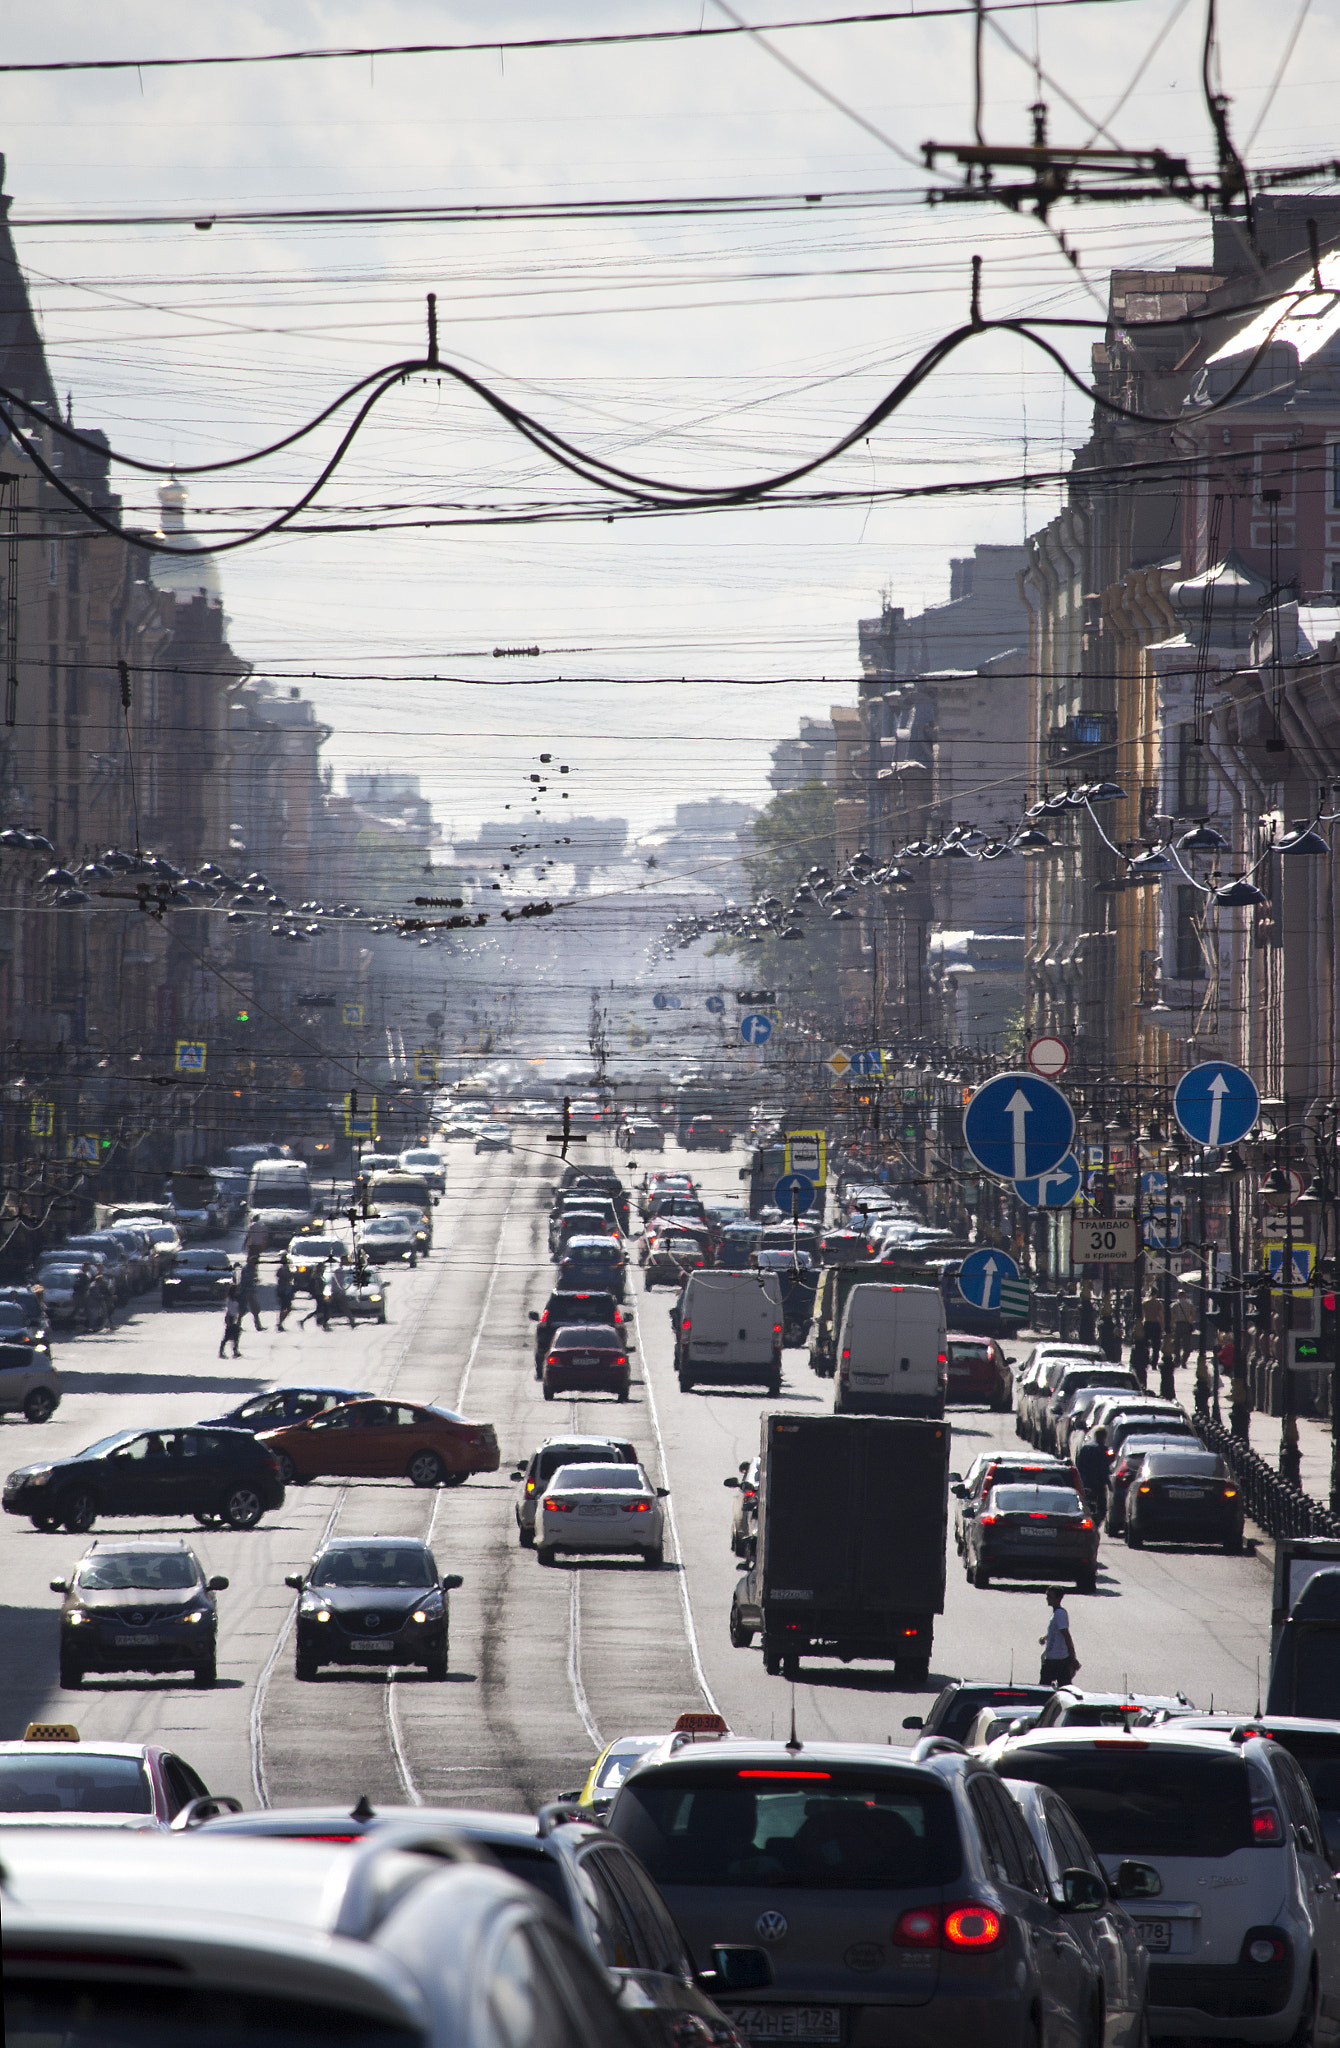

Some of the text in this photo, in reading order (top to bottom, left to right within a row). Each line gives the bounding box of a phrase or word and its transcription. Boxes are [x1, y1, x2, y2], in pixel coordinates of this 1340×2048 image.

[1079, 1221, 1130, 1230] ТРАМВАЮ
[1090, 1231, 1116, 1250] 30
[1093, 1251, 1127, 1260] кривой
[1138, 1923, 1164, 1938] 178
[799, 2009, 834, 2027] 178
